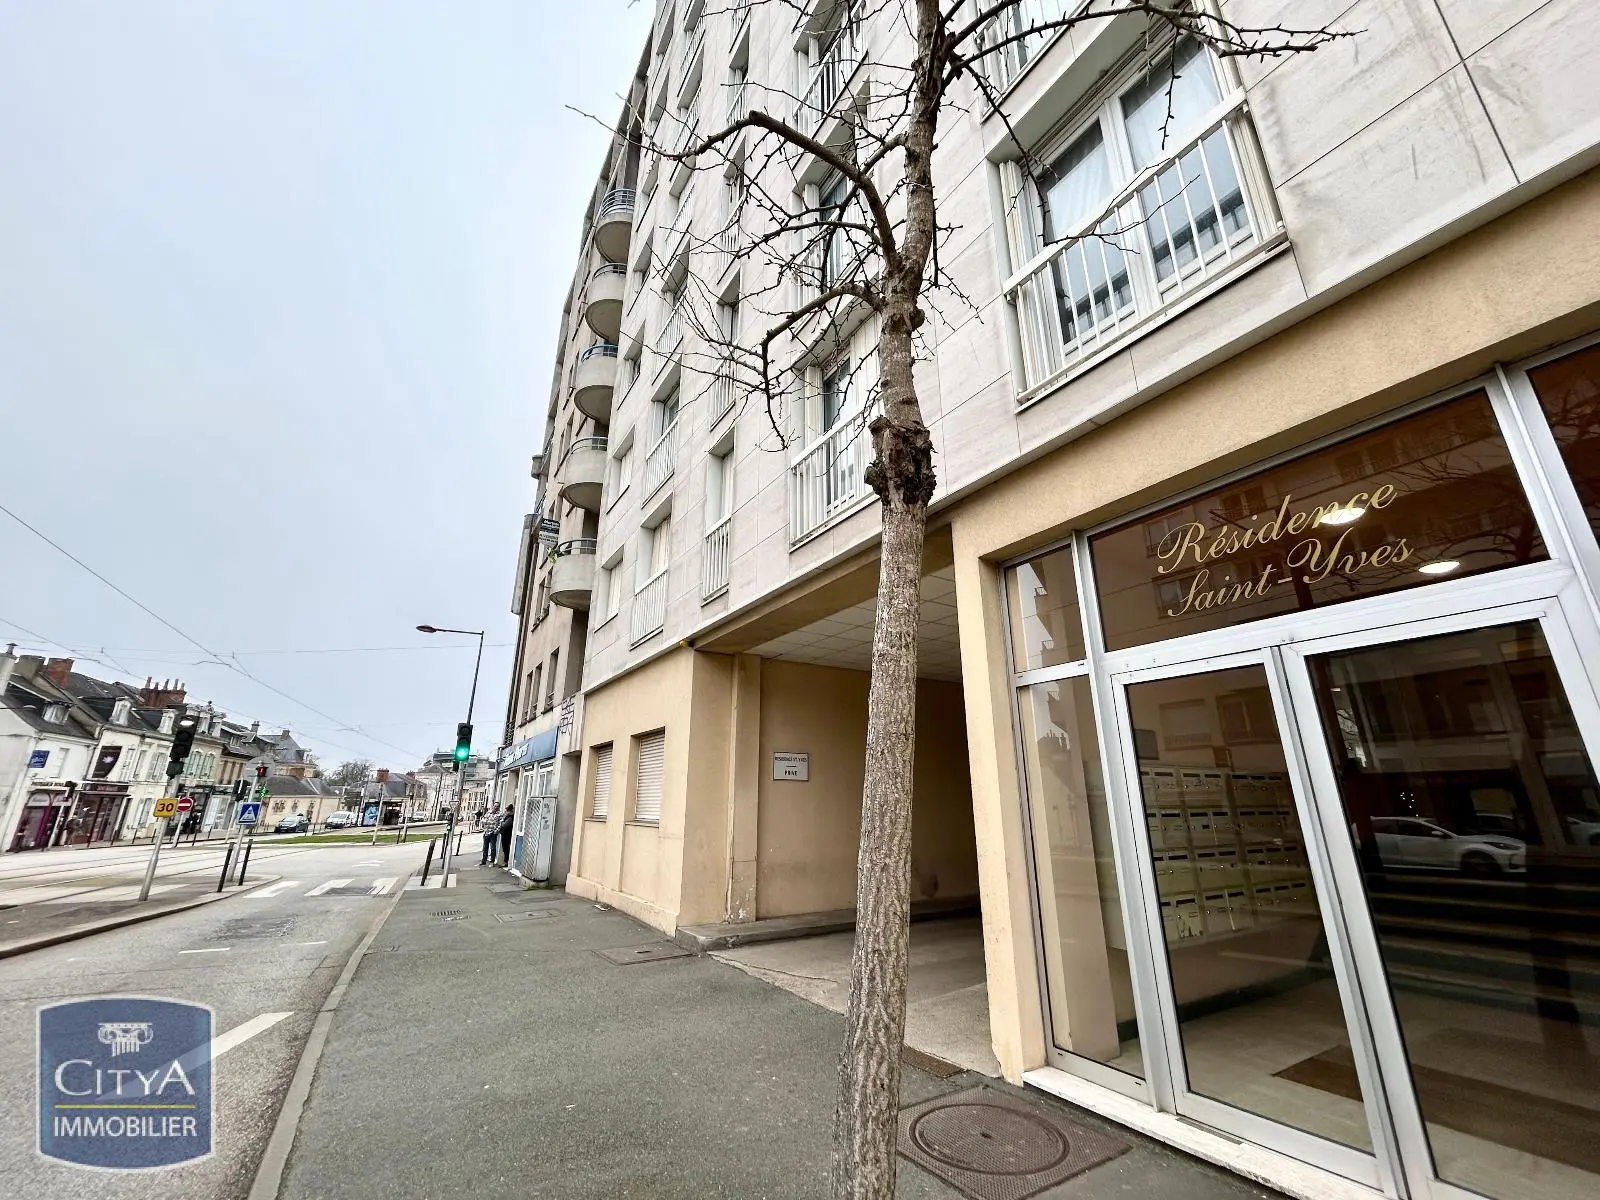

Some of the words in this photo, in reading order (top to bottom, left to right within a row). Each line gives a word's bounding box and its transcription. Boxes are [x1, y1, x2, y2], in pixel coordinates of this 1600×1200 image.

[1157, 483, 1398, 574] Résidence
[1167, 527, 1414, 617] Saint-Yves
[157, 803, 174, 812] 30
